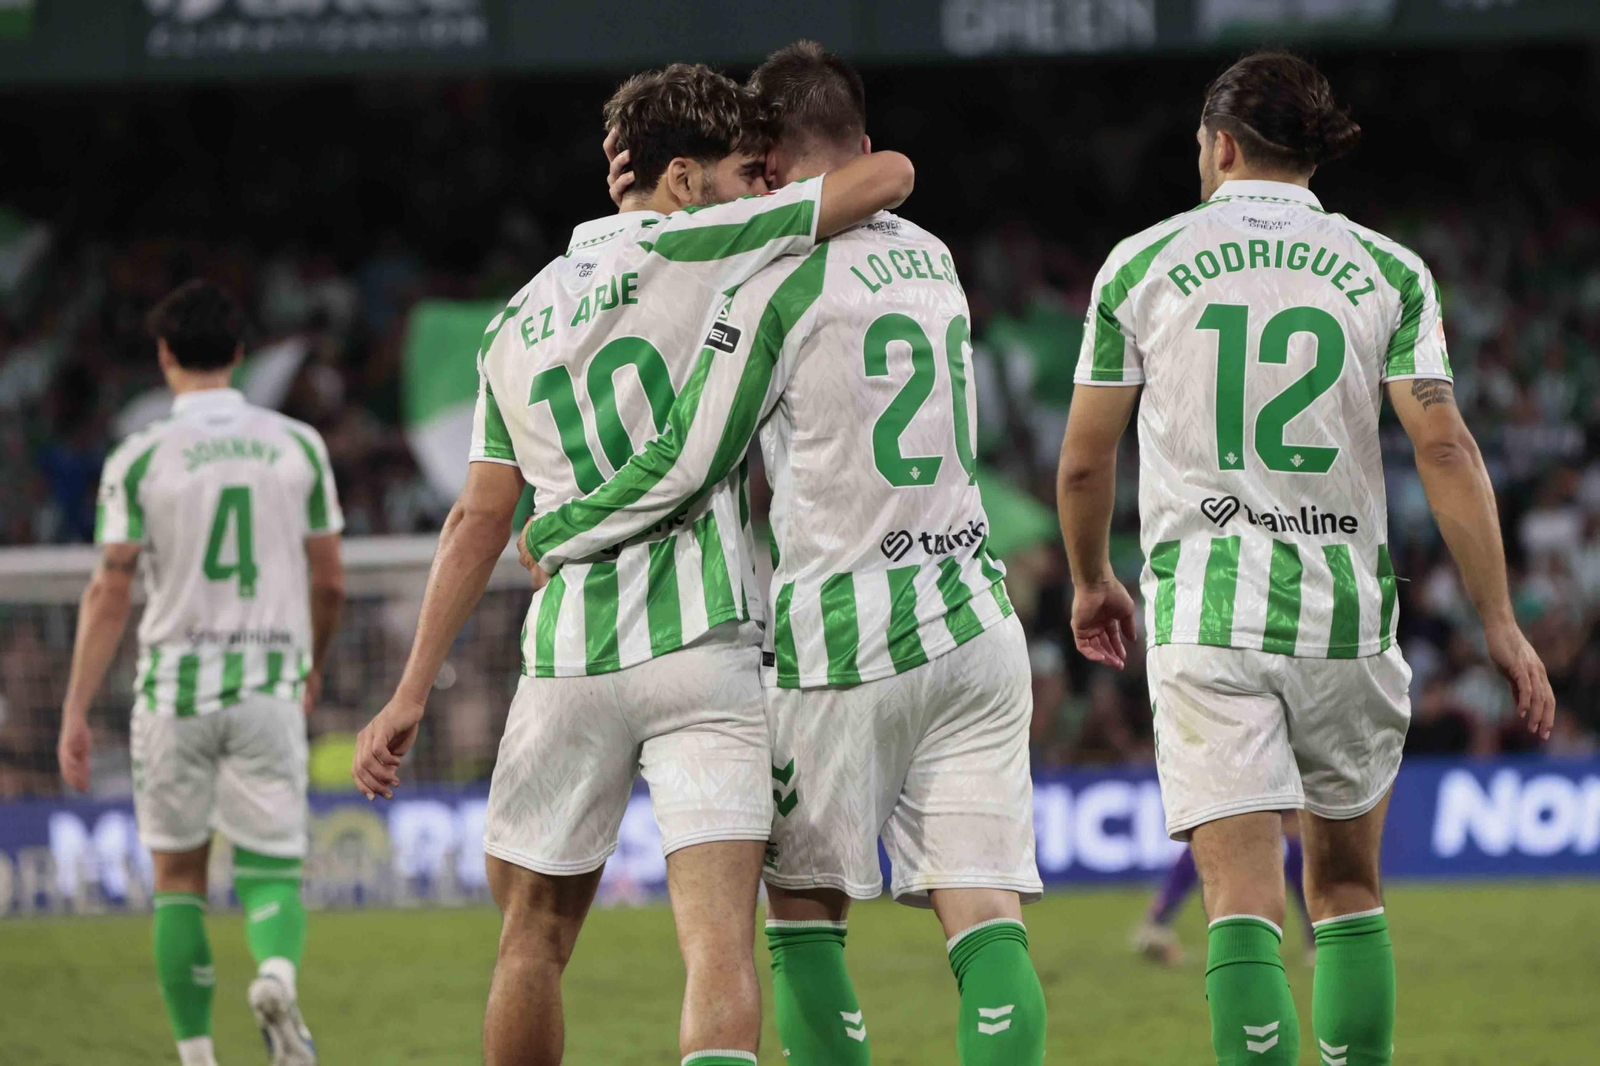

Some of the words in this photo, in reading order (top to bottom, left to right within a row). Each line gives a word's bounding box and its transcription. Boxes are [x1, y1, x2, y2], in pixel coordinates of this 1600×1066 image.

[850, 254, 893, 294] LO
[1167, 239, 1376, 307] RODRIGUEZ
[520, 305, 555, 351] EZ
[527, 335, 678, 497] 10
[862, 312, 977, 488] 20
[1194, 302, 1347, 475] 12
[203, 486, 258, 598] 4
[1244, 503, 1359, 535] tainline
